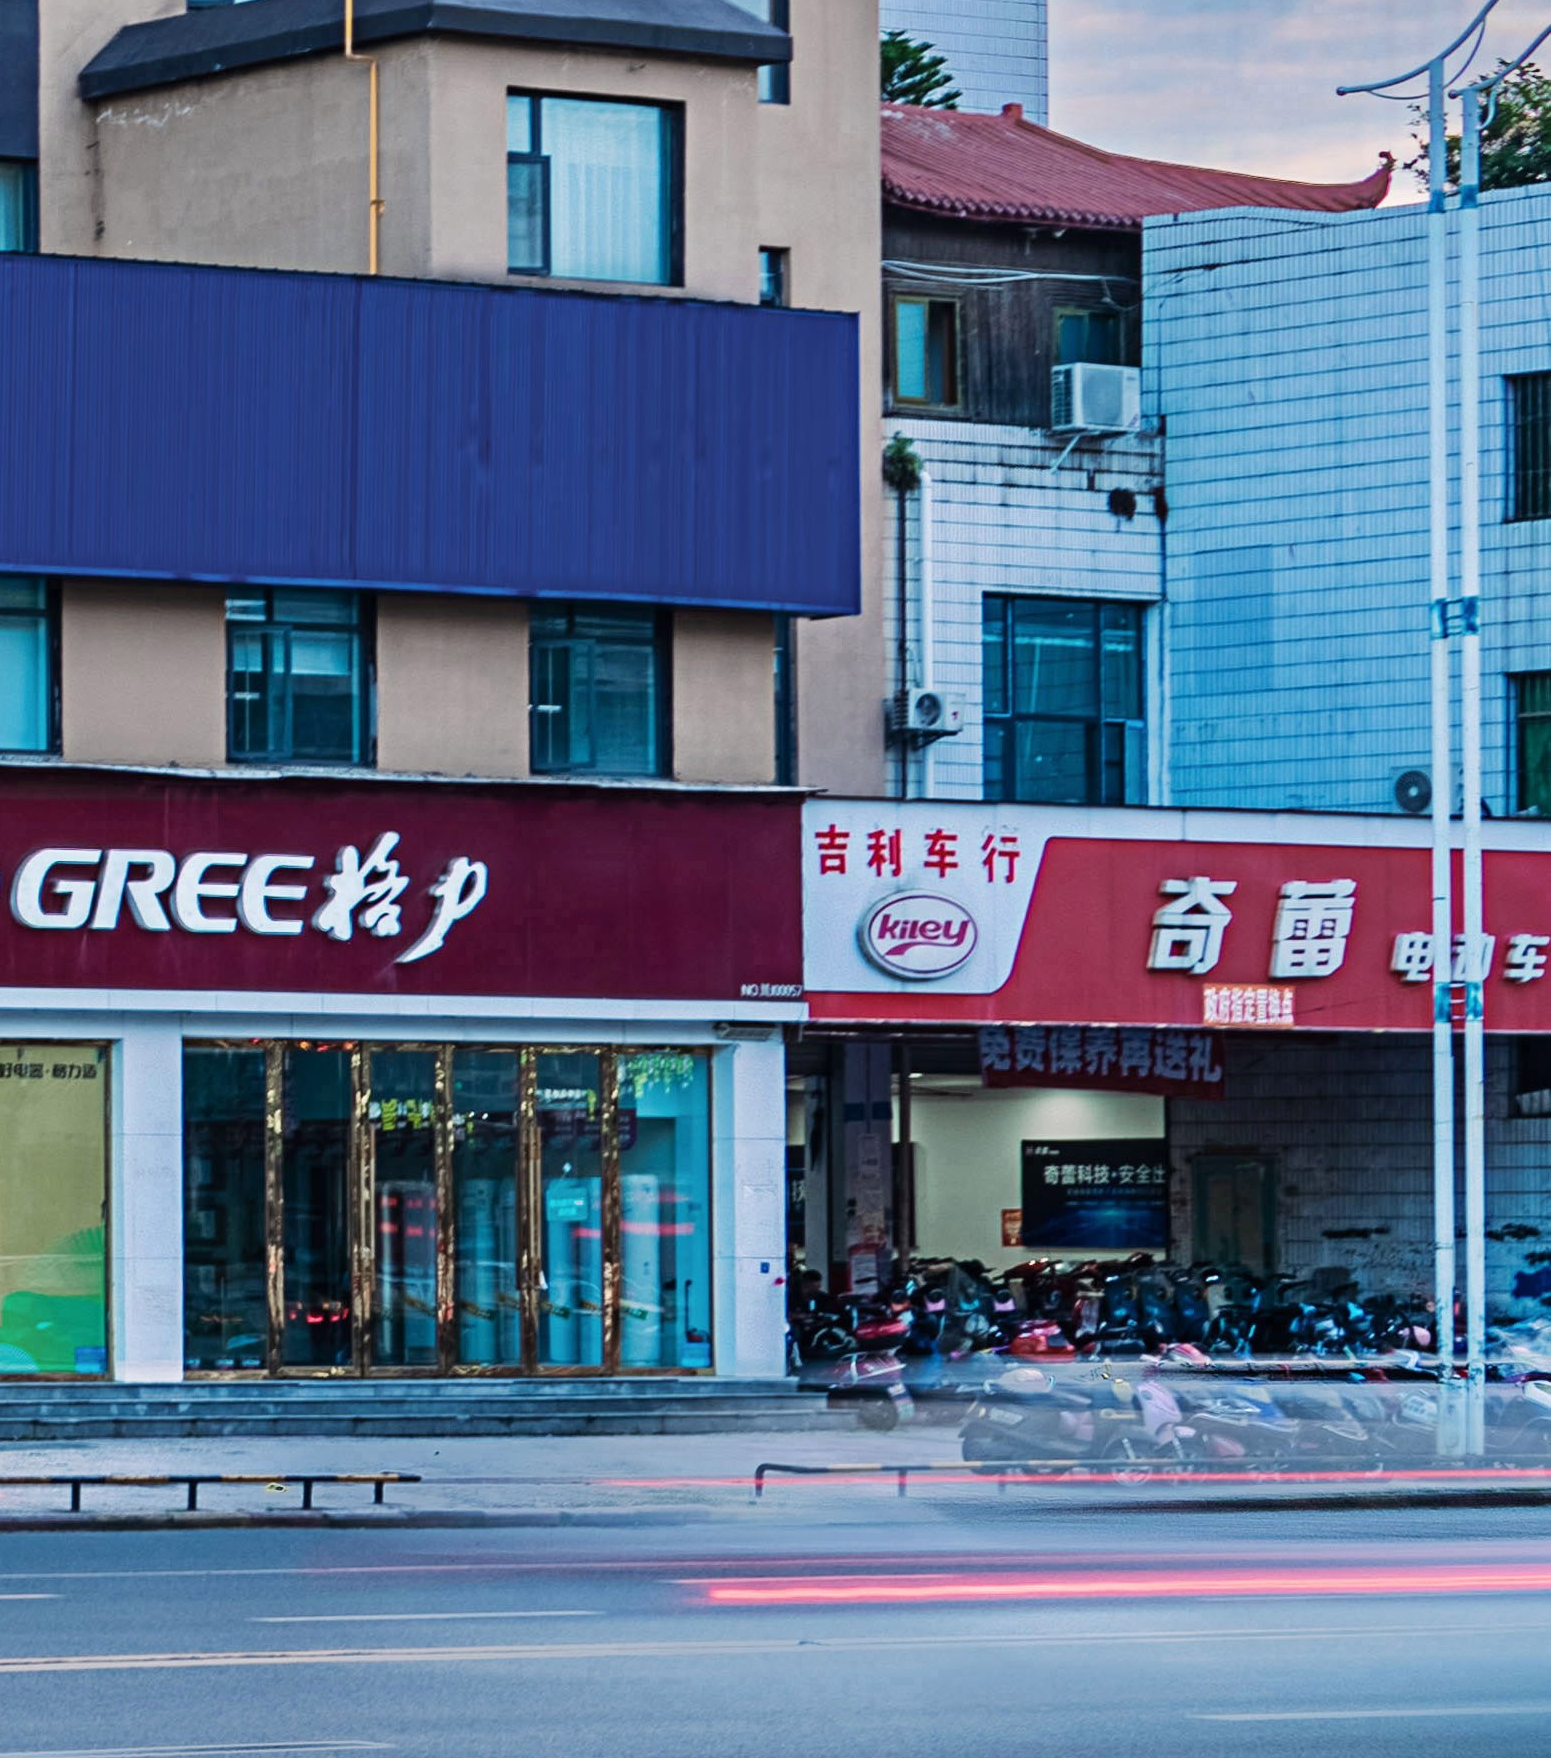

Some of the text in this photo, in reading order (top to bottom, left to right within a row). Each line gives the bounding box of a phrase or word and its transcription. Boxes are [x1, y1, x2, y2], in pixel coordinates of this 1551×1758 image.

[10, 831, 489, 964] GREE 格力
[814, 823, 1021, 884] 吉利车行
[1147, 877, 1358, 979] 奇蕾
